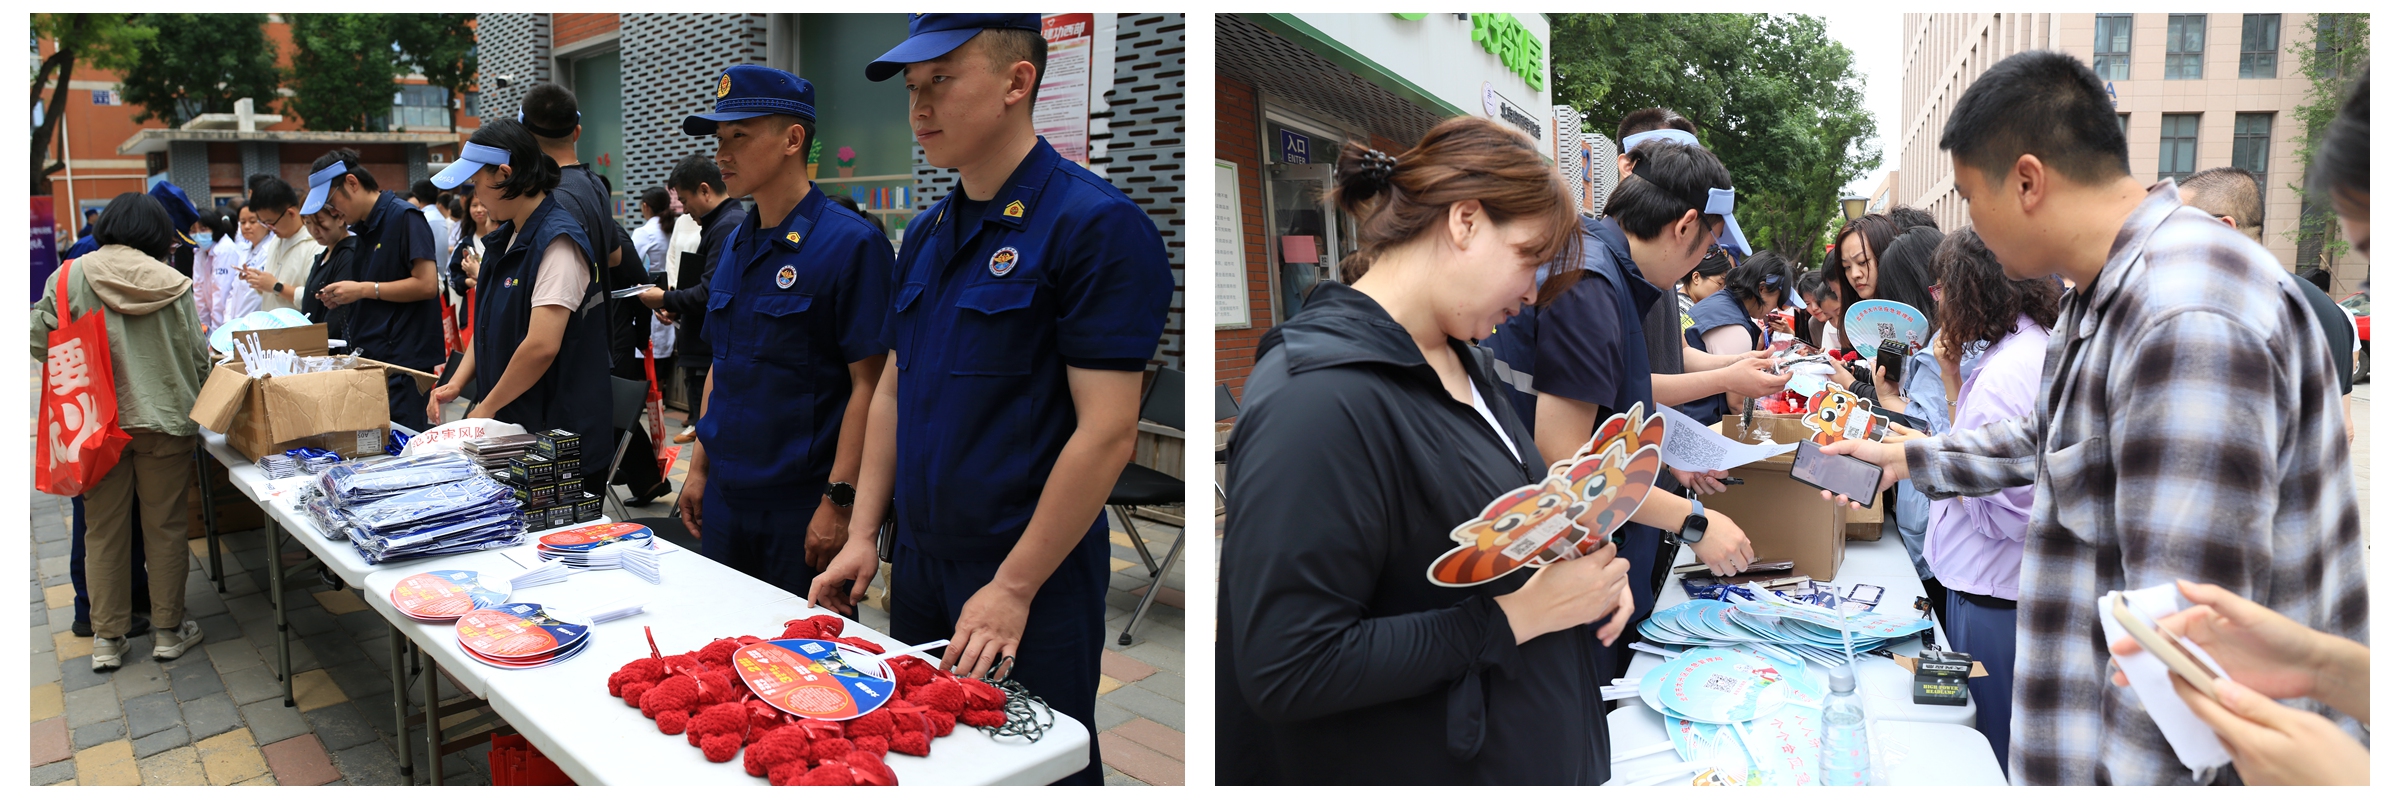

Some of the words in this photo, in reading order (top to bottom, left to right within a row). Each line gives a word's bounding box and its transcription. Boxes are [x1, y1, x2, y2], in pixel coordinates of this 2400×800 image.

[1471, 13, 1543, 92] 好邻居
[1287, 134, 1306, 154] 入口
[1287, 153, 1306, 165] ENTER
[1856, 305, 1914, 323] 北京市大兴区应急管理局
[1770, 718, 1811, 787] 个个会应急
